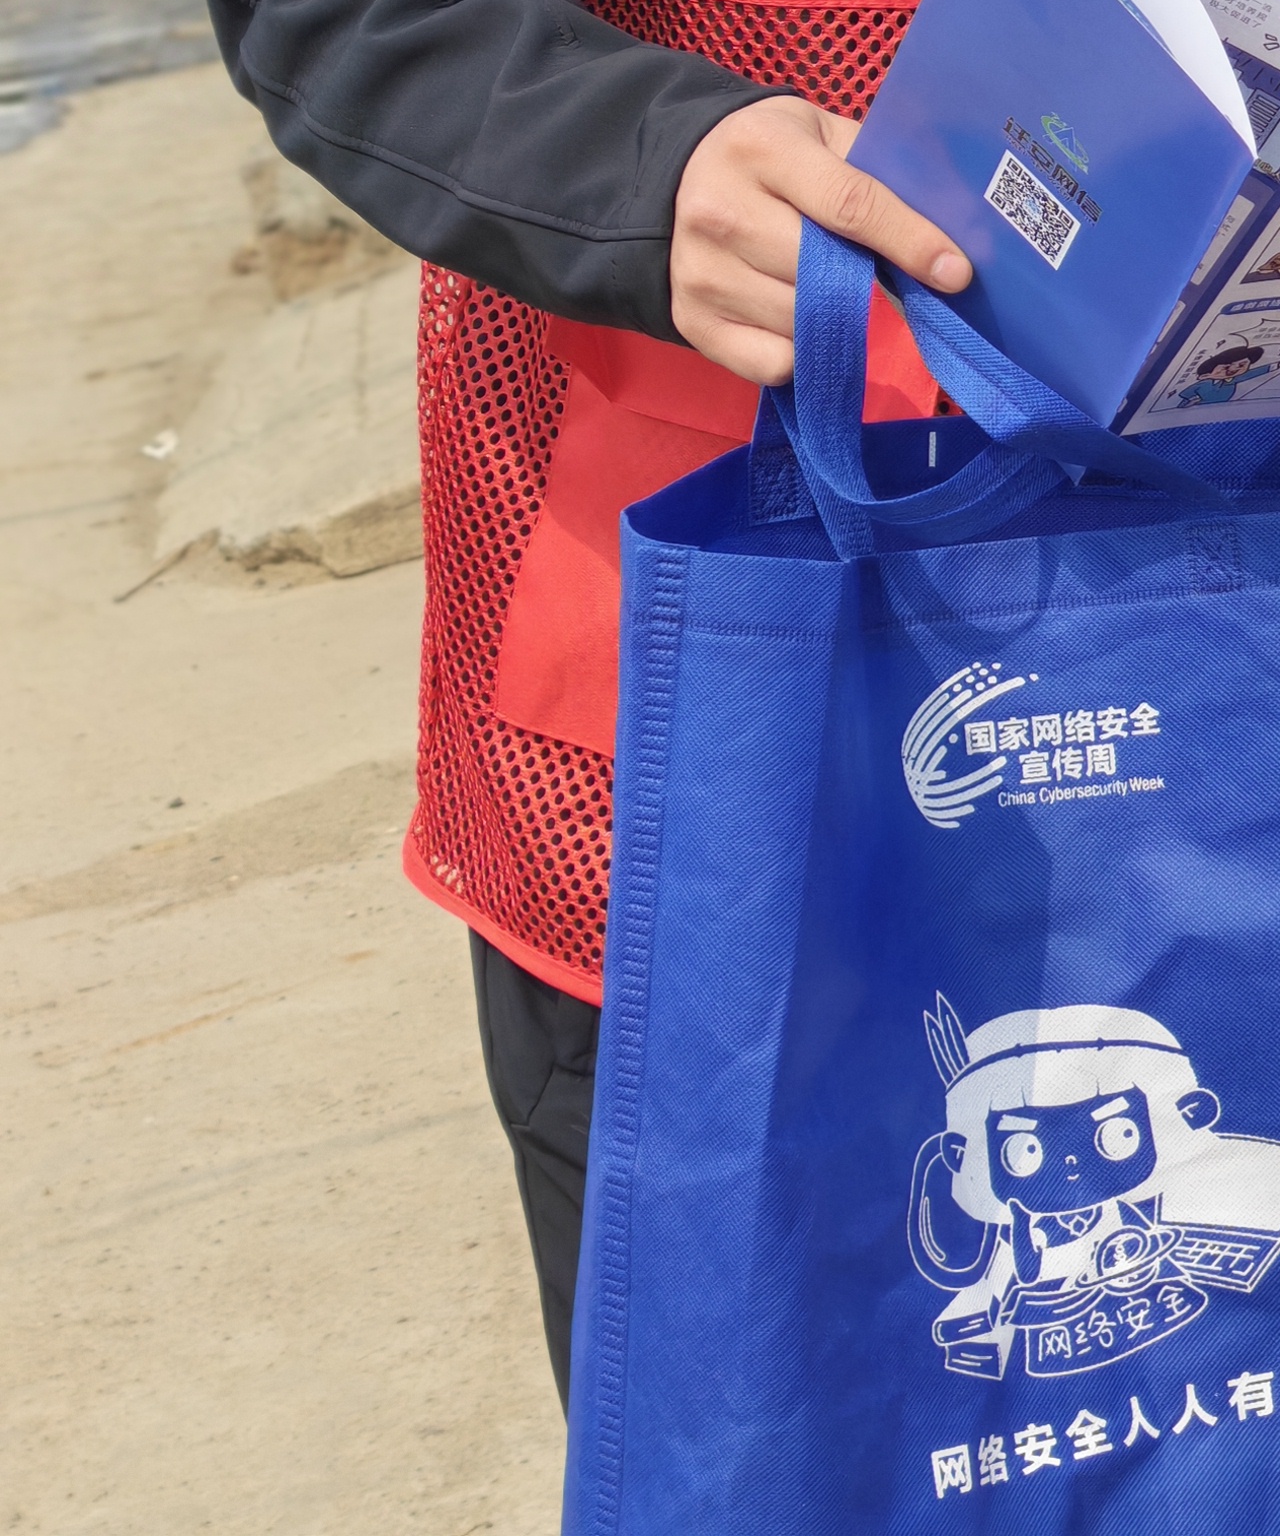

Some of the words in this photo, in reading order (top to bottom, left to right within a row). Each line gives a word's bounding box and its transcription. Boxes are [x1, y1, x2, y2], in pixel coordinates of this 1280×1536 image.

[964, 702, 1161, 756] 国家网络安全
[1018, 742, 1117, 785] 宣传周
[998, 784, 1036, 808] China
[1039, 779, 1129, 806] Cybersecurity
[1129, 774, 1165, 793] Week
[1036, 1286, 1192, 1361] 网络安全
